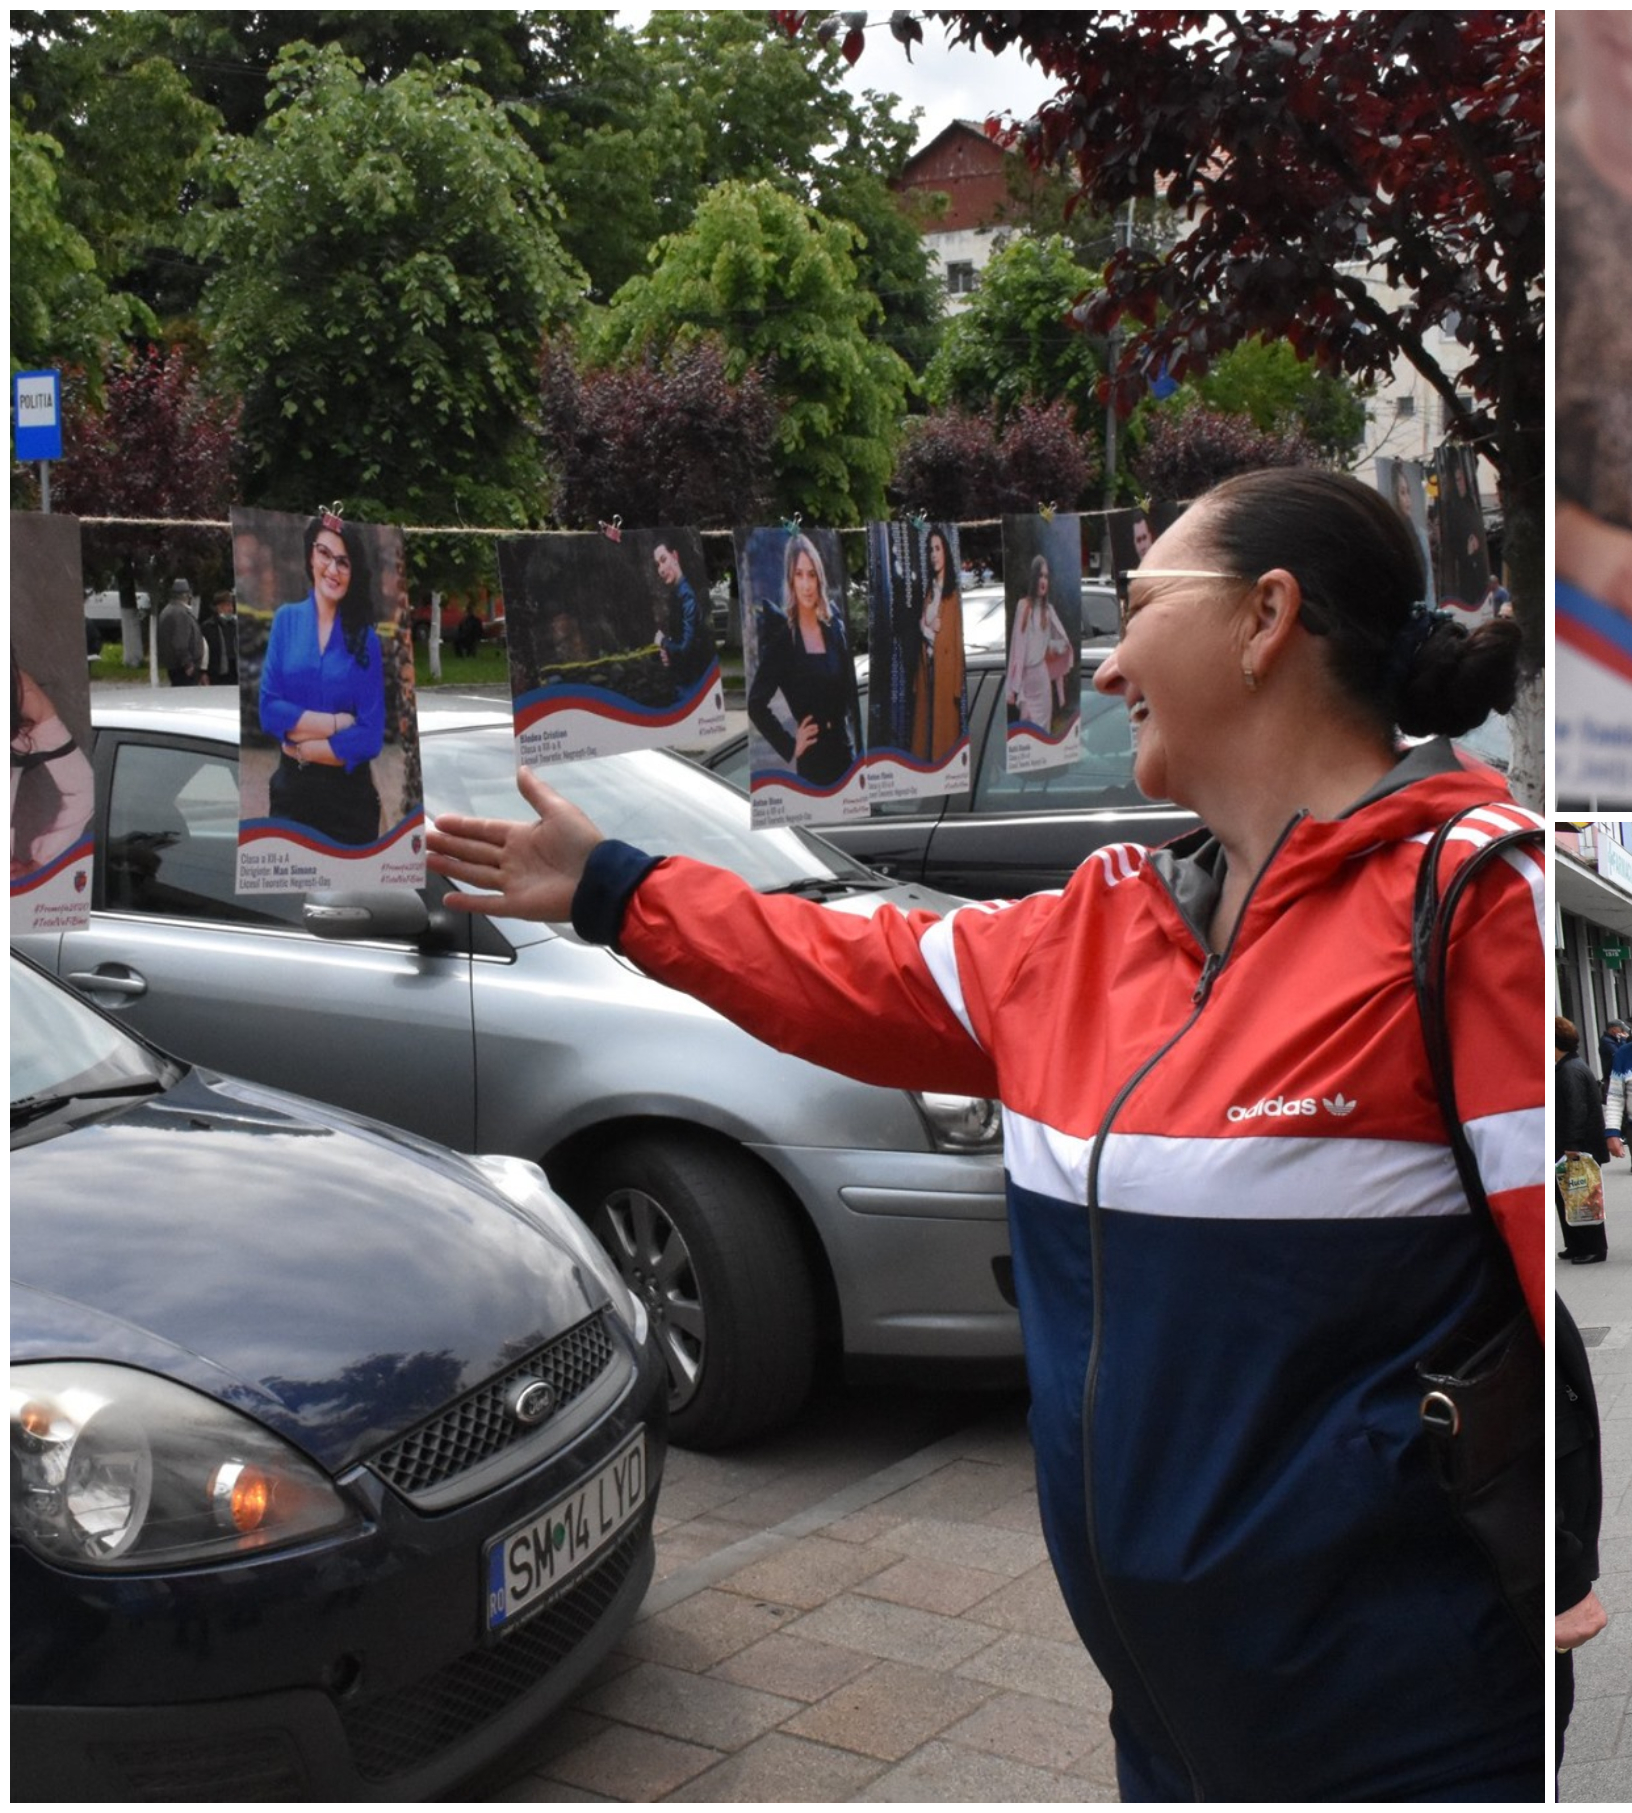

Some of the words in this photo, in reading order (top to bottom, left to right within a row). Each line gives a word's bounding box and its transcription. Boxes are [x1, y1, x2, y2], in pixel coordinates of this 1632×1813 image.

[290, 865, 317, 875] Simona
[1226, 1095, 1317, 1122] adidas
[529, 1391, 550, 1415] Ford
[508, 1517, 554, 1601] SM
[564, 1493, 590, 1562] 14
[599, 1446, 642, 1535] LYD
[490, 1588, 505, 1617] RO
